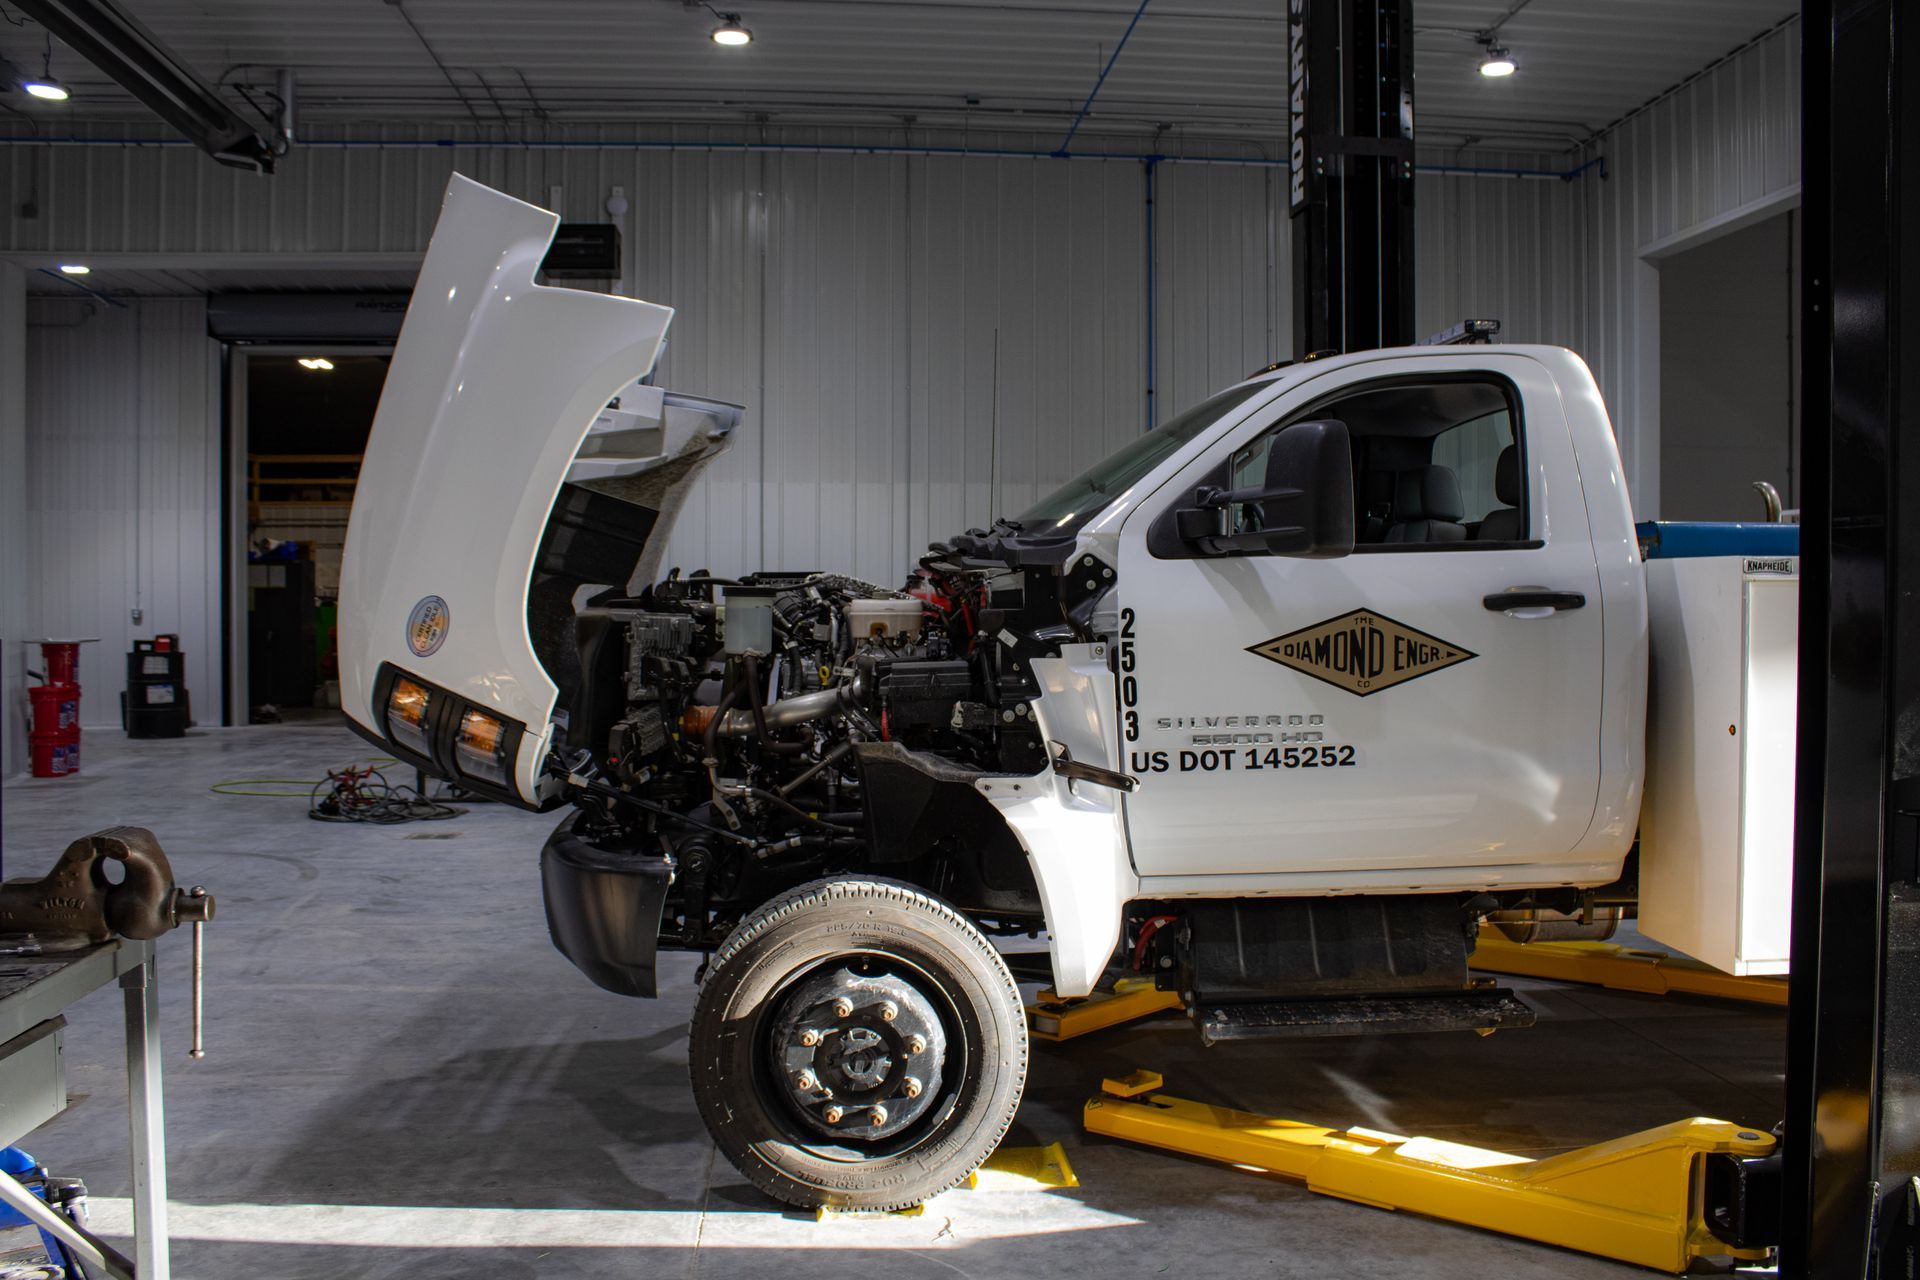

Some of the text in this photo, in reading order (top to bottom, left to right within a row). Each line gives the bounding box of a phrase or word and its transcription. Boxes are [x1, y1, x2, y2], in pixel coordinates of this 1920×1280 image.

[1291, 23, 1304, 207] ROTARY
[1747, 560, 1790, 572] KNAPHEIDE
[1354, 617, 1374, 625] THE
[1283, 627, 1444, 679] DIAMOND ENGR.
[1120, 608, 1139, 741] 2503
[1157, 714, 1324, 730] SILVERADO
[1281, 731, 1323, 744] HD
[1131, 745, 1356, 773] US DOT 145252
